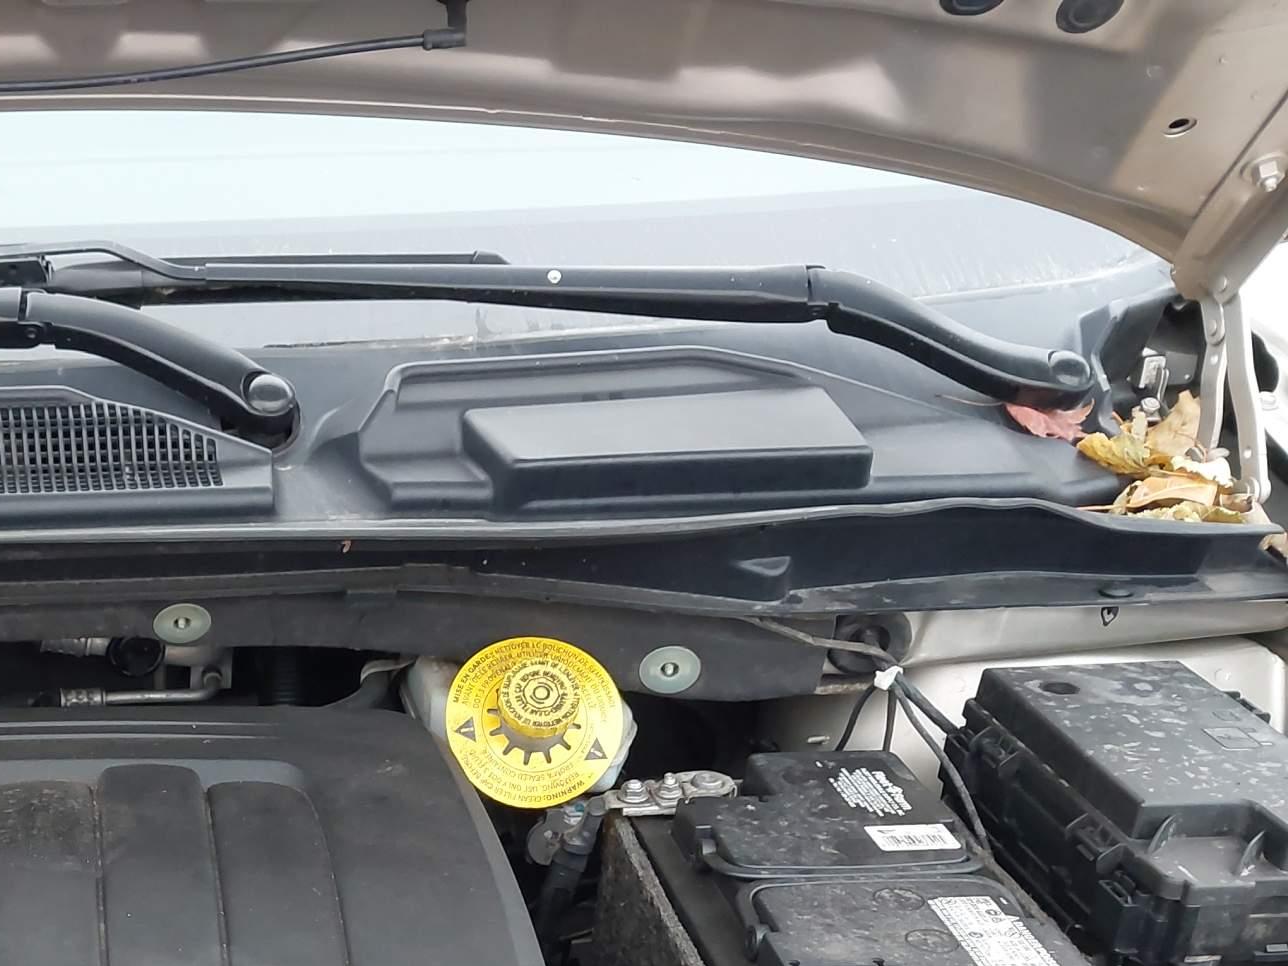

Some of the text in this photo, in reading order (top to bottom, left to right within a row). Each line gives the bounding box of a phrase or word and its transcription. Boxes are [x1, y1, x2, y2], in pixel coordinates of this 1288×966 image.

[451, 682, 465, 703] MISE
[459, 672, 471, 684] EN
[458, 681, 475, 705] AVANT
[469, 692, 483, 708] DOT
[543, 779, 585, 800] WARNING:
